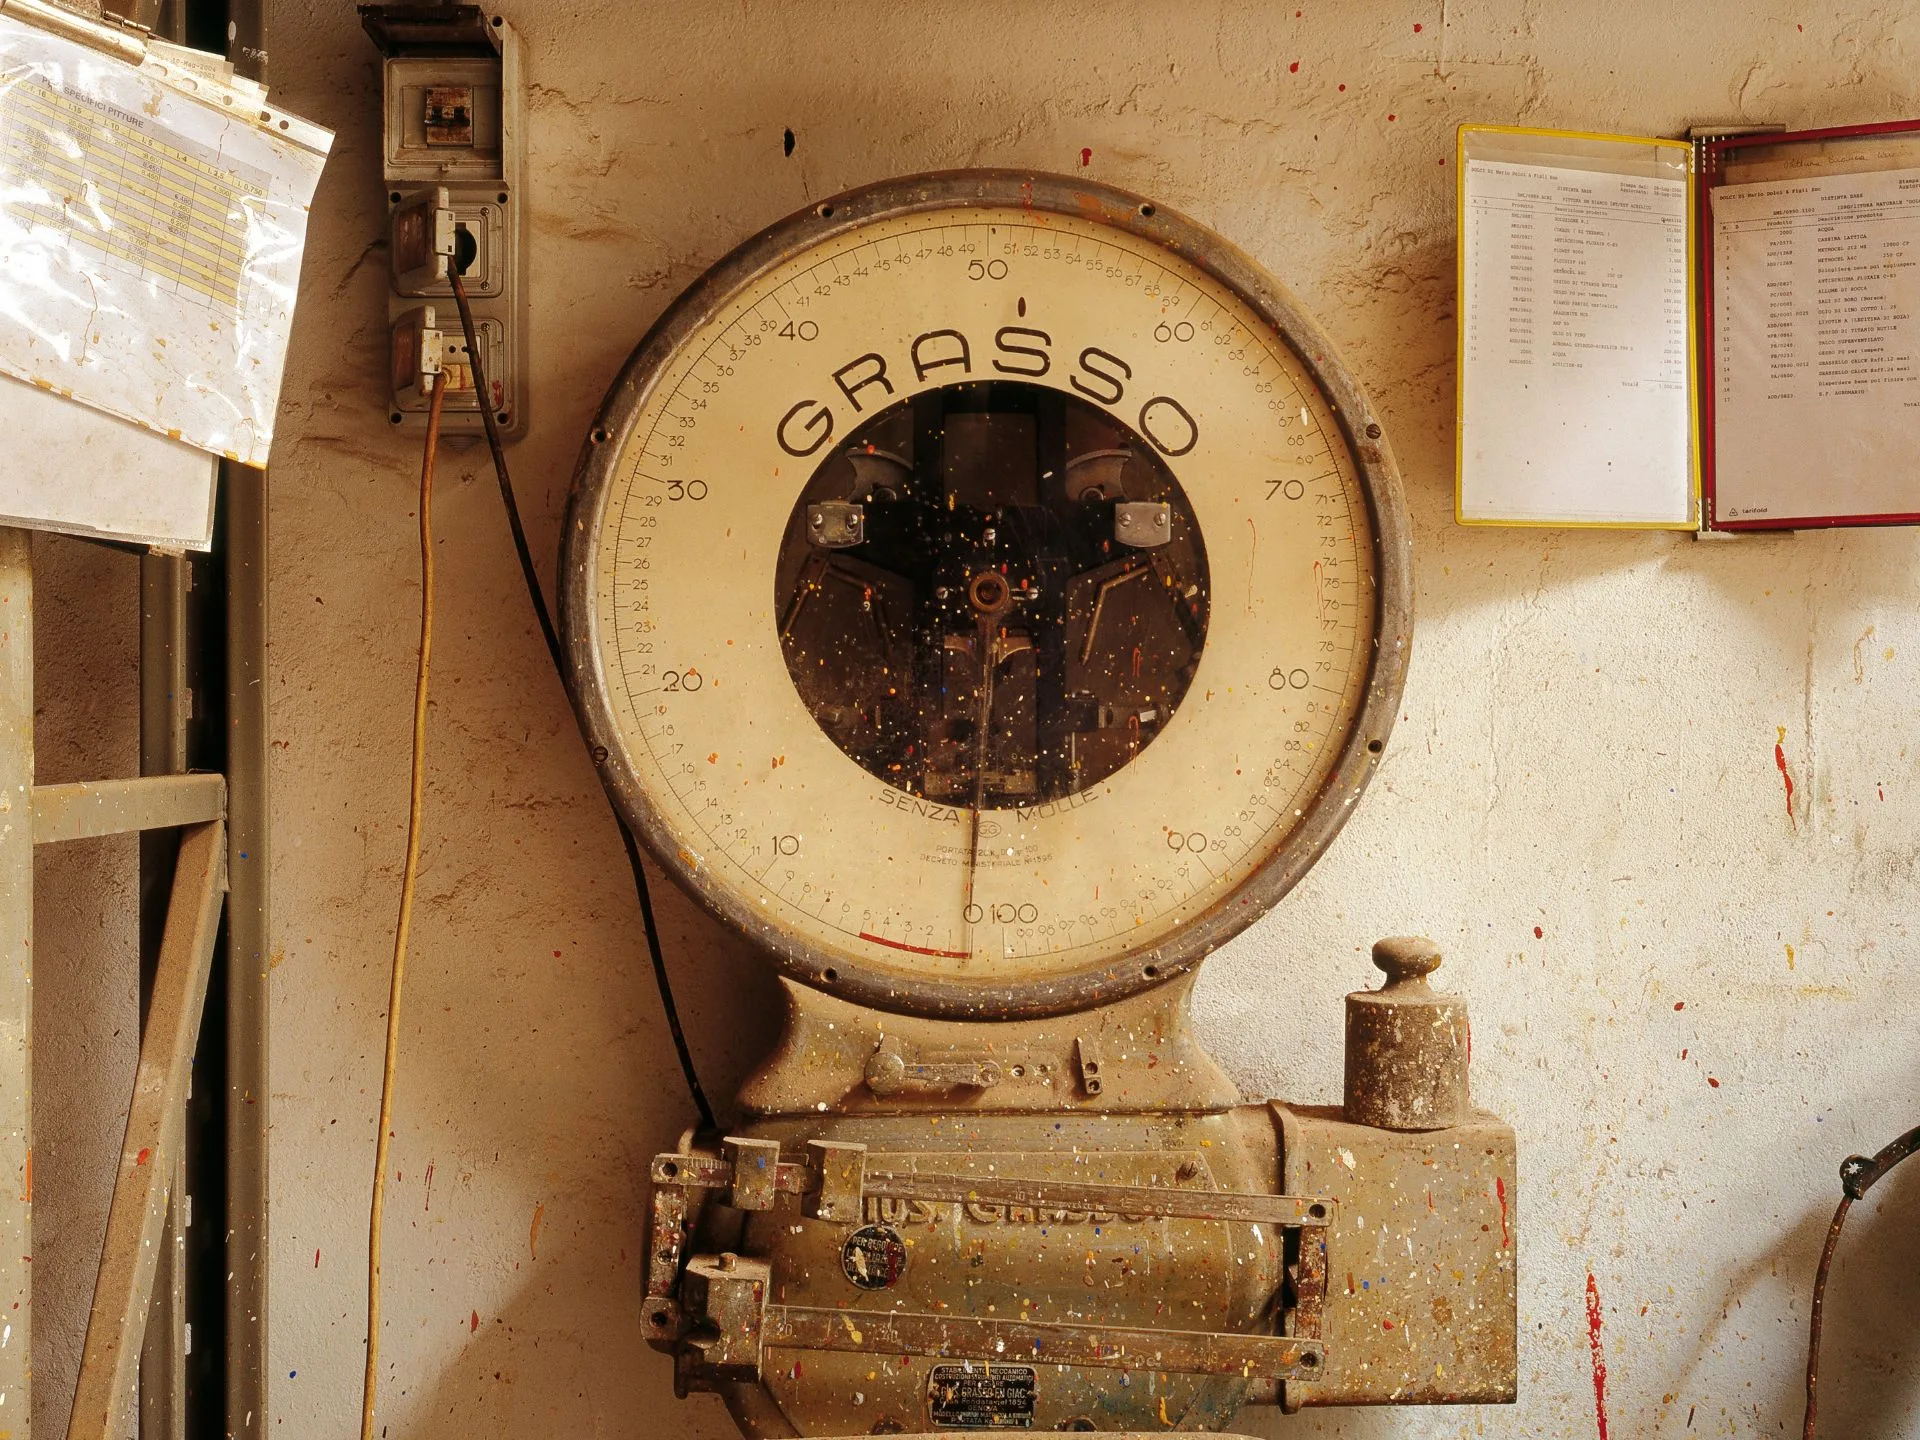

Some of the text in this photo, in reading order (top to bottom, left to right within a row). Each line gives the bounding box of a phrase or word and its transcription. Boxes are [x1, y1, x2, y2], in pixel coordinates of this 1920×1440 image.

[108, 107, 145, 129] PITTURE
[111, 123, 120, 131] 10
[916, 249, 932, 259] 47
[937, 246, 953, 256] 48
[958, 244, 975, 254] 49
[1004, 244, 1016, 254] 51
[1024, 246, 1038, 256] 52
[894, 254, 911, 264] 46
[1044, 249, 1060, 260] 53
[1066, 254, 1081, 264] 54
[874, 260, 890, 270] 45
[968, 260, 1008, 280] 50
[1086, 260, 1103, 270] 55
[853, 267, 868, 277] 44
[1106, 268, 1122, 278] 56
[834, 276, 850, 286] 43
[1125, 276, 1142, 286] 57
[814, 286, 830, 296] 42
[1144, 285, 1160, 296] 58
[796, 297, 810, 306] 41
[1162, 296, 1180, 306] 59
[760, 321, 777, 332] 39
[1200, 320, 1212, 330] 61
[778, 320, 818, 341] 40
[1154, 321, 1194, 342] 60
[744, 335, 761, 346] 38
[1214, 334, 1231, 345] 62
[730, 350, 746, 360] 37
[1228, 350, 1244, 360] 63
[716, 366, 734, 376] 36
[1243, 366, 1259, 376] 64
[703, 382, 720, 393] 35
[777, 326, 1199, 457] GRASSO
[1255, 383, 1272, 392] 65
[690, 400, 707, 410] 34
[1268, 400, 1285, 410] 66
[680, 417, 696, 428] 33
[1278, 416, 1294, 427] 67
[668, 436, 684, 446] 32
[1287, 434, 1304, 446] 68
[660, 456, 672, 466] 31
[1296, 454, 1314, 465] 69
[667, 480, 708, 500] 30
[1265, 480, 1304, 500] 70
[646, 496, 662, 506] 29
[1316, 494, 1328, 504] 71
[640, 517, 656, 527] 28
[1317, 516, 1332, 526] 72
[636, 538, 651, 548] 27
[1320, 536, 1336, 547] 73
[634, 558, 650, 568] 26
[1322, 558, 1338, 568] 74
[632, 580, 648, 590] 25
[1324, 578, 1340, 588] 75
[632, 601, 648, 611] 24
[1324, 600, 1340, 610] 76
[635, 622, 650, 632] 23
[1322, 620, 1338, 630] 77
[637, 643, 653, 653] 22
[1319, 641, 1335, 652] 78
[642, 664, 655, 674] 21
[1316, 662, 1332, 672] 79
[662, 670, 702, 692] 20
[1269, 667, 1309, 690] 80
[1306, 702, 1319, 713] 81
[662, 725, 674, 736] 18
[670, 744, 684, 754] 17
[1284, 740, 1300, 751] 83
[682, 762, 694, 773] 16
[1274, 759, 1290, 770] 84
[694, 781, 706, 791] 15
[1264, 776, 1280, 786] 85
[706, 798, 718, 808] 14
[1250, 795, 1266, 805] 86
[879, 787, 1099, 824] SENZA MOLLE
[720, 814, 732, 824] 13
[1240, 811, 1256, 822] 87
[734, 829, 747, 839] 12
[1224, 826, 1241, 836] 88
[772, 836, 799, 856] 10
[1168, 832, 1207, 854] 90
[1211, 840, 1227, 851] 89
[751, 846, 760, 855] 11
[962, 859, 1022, 867] MNISTERIALE
[786, 871, 794, 882] 9
[803, 882, 811, 893] 8
[1158, 880, 1173, 890] 92
[842, 902, 850, 912] 6
[1120, 899, 1136, 910] 94
[863, 910, 870, 920] 5
[964, 904, 983, 924] 0
[990, 904, 1038, 924] 100
[1100, 908, 1117, 918] 95
[883, 917, 890, 925] 4
[1059, 920, 1075, 930] 97
[905, 922, 912, 932] 3
[926, 926, 934, 936] 2
[1038, 925, 1055, 936] 98
[1016, 928, 1033, 938] 99
[990, 1367, 1028, 1375] MECCANICO
